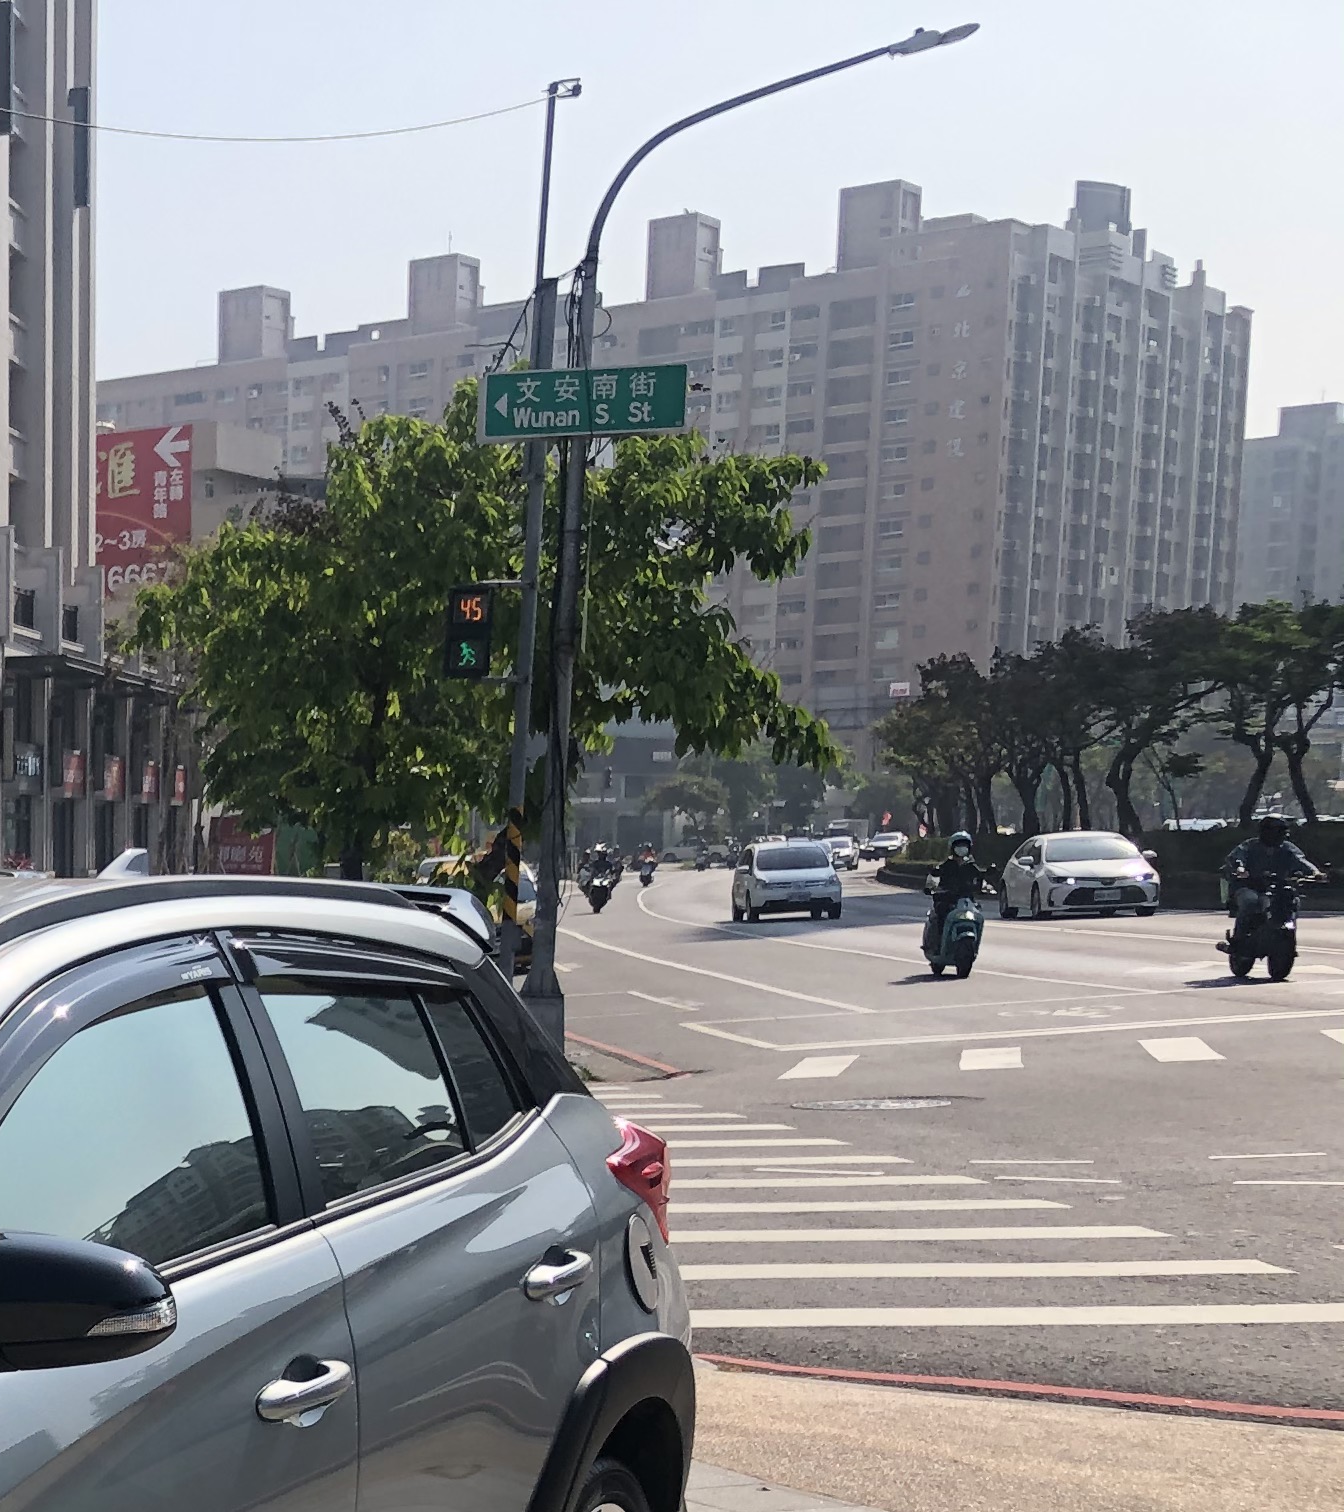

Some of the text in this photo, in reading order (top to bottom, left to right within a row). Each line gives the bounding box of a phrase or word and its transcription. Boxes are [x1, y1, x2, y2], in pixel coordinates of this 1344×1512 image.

[516, 371, 657, 403] 文安南街
[513, 401, 655, 428] Wunan S. St.
[460, 597, 482, 620] 45
